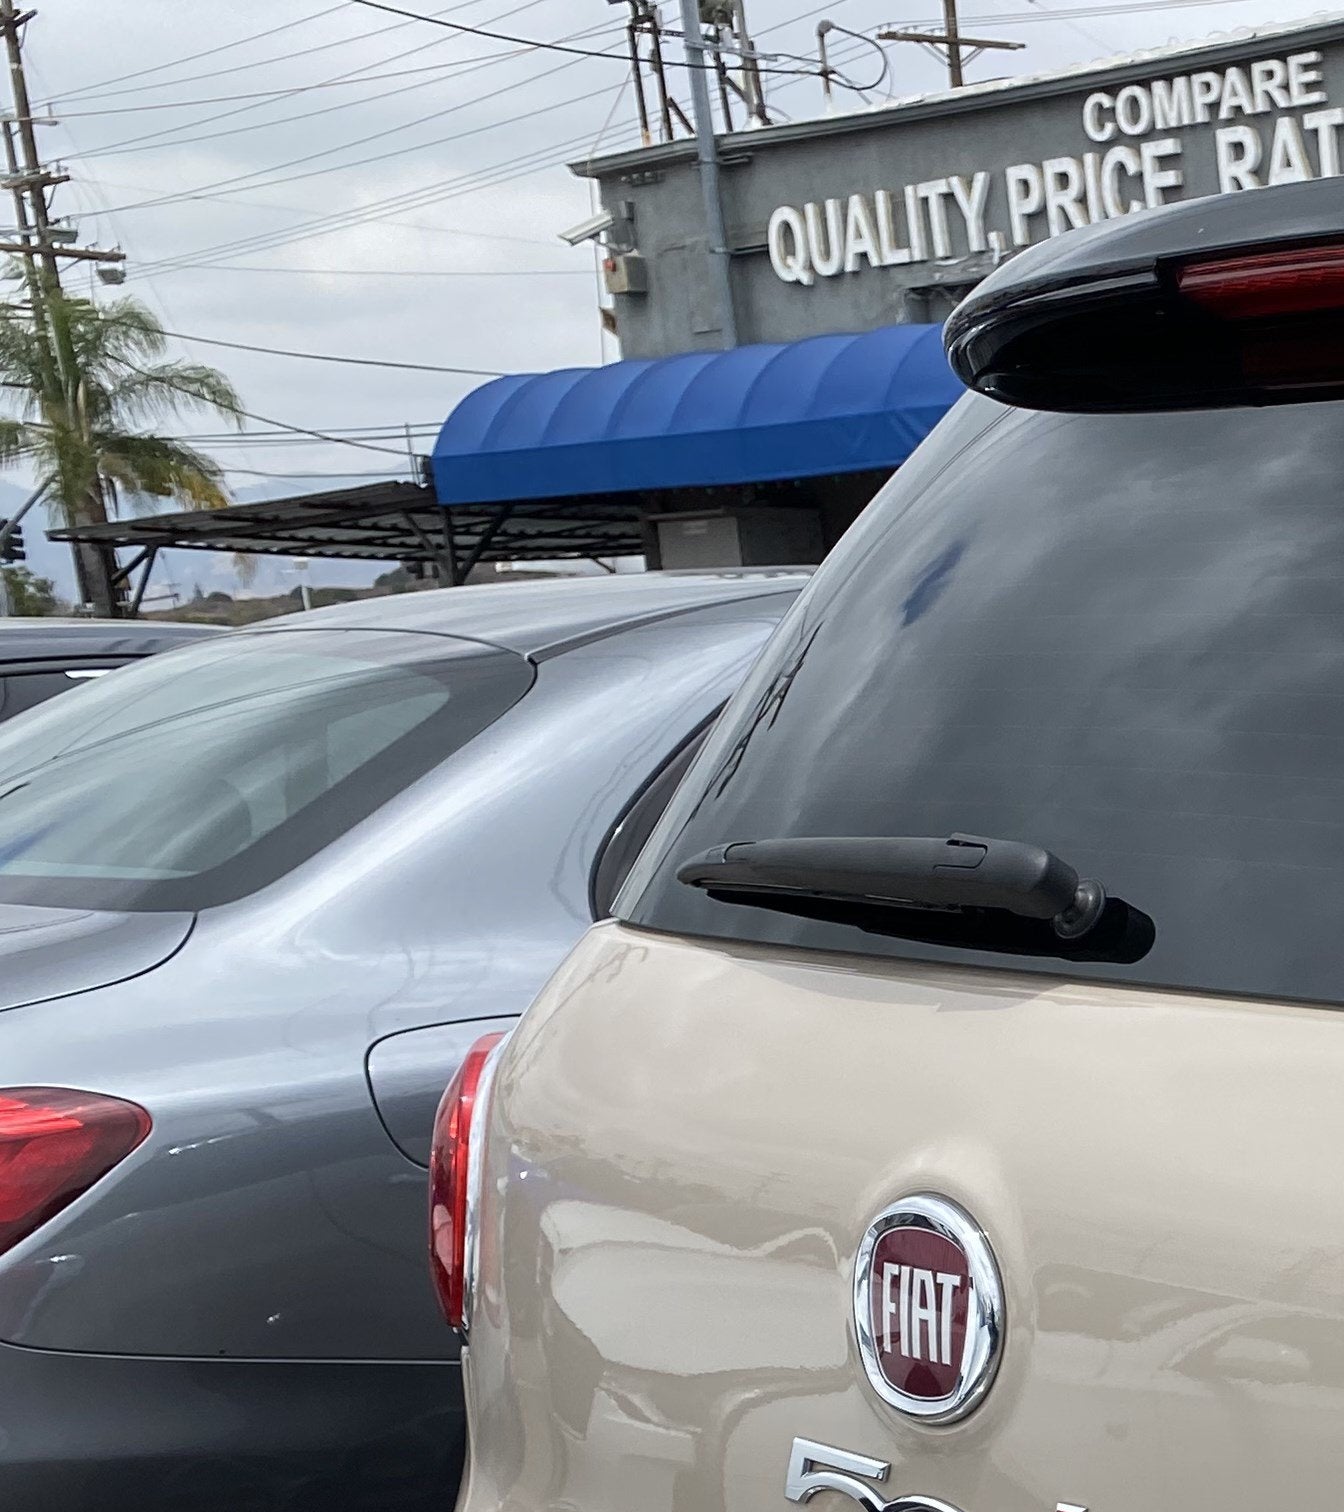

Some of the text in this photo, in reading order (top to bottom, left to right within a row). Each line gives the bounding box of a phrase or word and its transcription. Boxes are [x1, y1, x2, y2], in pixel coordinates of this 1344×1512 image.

[1083, 51, 1327, 141] COMPARE
[768, 171, 1006, 286] QUALITY,
[1005, 138, 1183, 246] PRICE
[882, 1262, 961, 1366] FIAT
